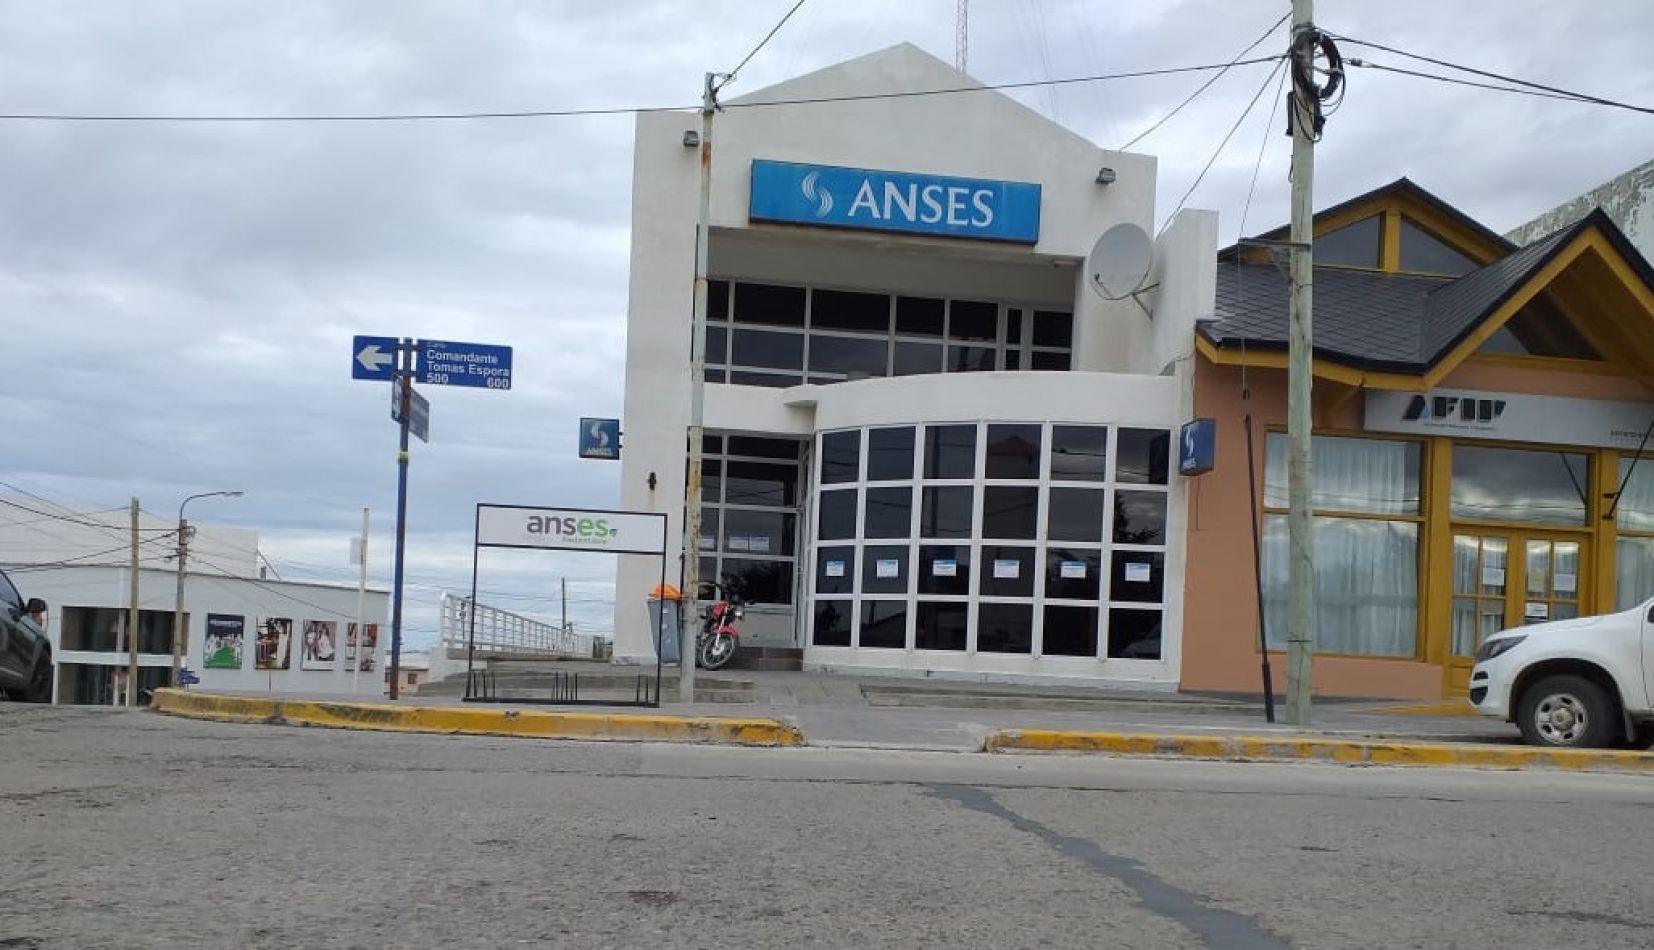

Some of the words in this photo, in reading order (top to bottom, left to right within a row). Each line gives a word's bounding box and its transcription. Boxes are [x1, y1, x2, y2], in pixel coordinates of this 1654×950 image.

[848, 178, 994, 227] ANSES
[426, 349, 498, 364] Comandante
[426, 360, 465, 374] Tomas
[468, 364, 510, 378] Espora
[426, 372, 448, 384] 500
